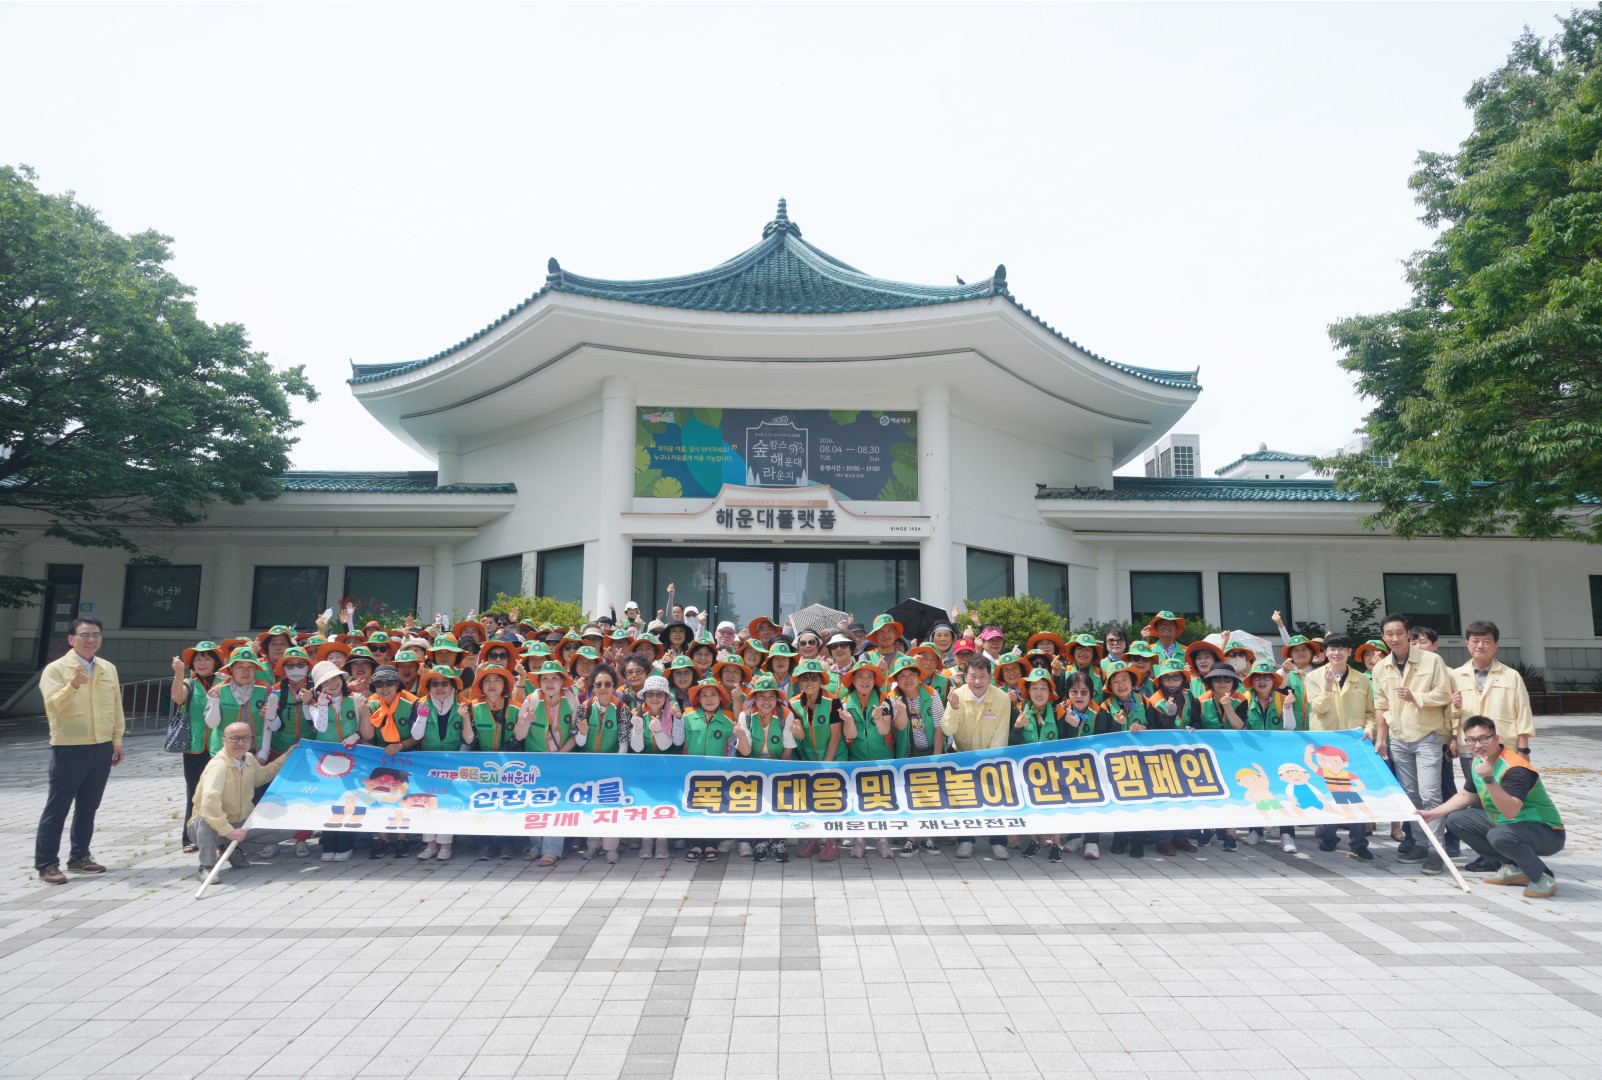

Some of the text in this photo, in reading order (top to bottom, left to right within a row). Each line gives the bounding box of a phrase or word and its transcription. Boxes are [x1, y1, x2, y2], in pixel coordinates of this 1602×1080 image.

[751, 439, 788, 458] 숲캉스
[819, 444, 843, 454] 08.04
[857, 445, 880, 454] 08.30
[769, 452, 802, 468] 해운대
[819, 464, 841, 472] 운영시간
[762, 466, 794, 481] 라운지
[715, 508, 837, 530] 해운대플랫폼
[459, 768, 479, 780] 좋은
[479, 774, 499, 784] 도시
[501, 770, 535, 785] 해운대
[691, 752, 1219, 813] 폭염 대응 및 물놀이 안전 캠페인
[472, 780, 632, 809] 안전한 여름,
[524, 805, 678, 830] 함께 지켜요
[823, 817, 1027, 832] 해운대구 재난안전과
